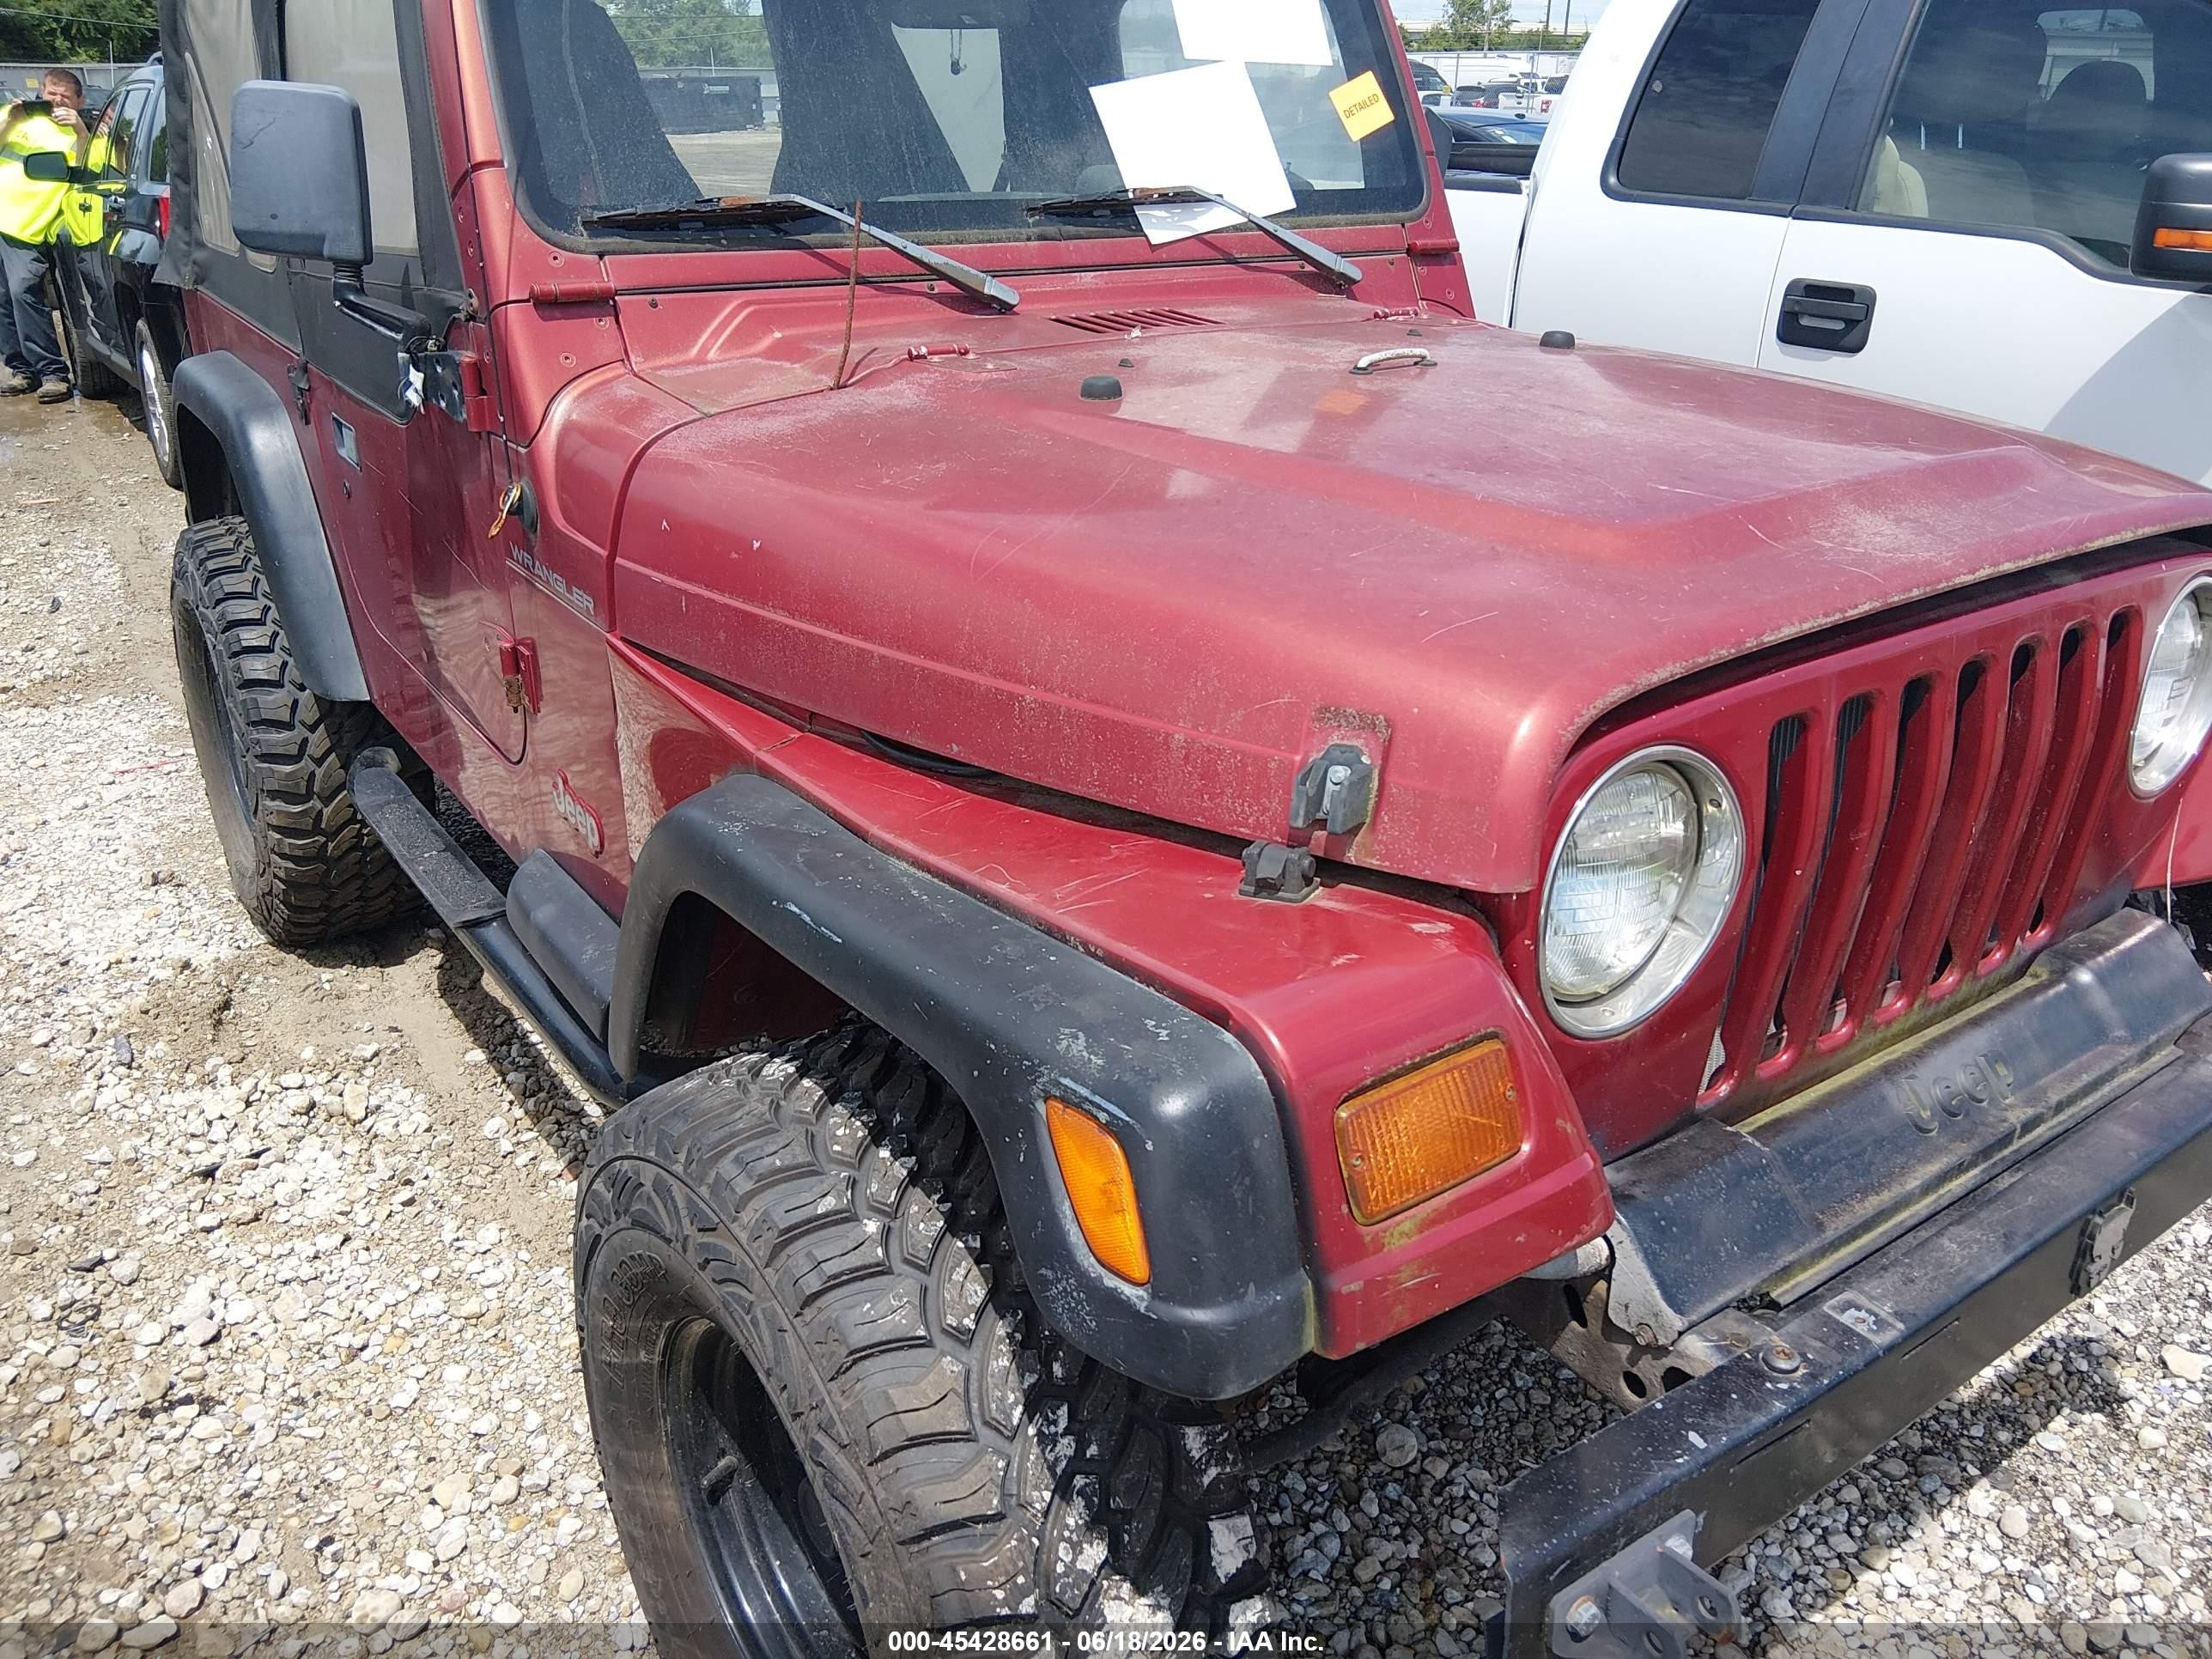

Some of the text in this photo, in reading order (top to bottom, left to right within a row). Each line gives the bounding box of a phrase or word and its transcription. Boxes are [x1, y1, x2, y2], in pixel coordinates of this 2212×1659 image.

[1343, 94, 1380, 118] DETAILED
[509, 541, 594, 616] WRANGLER
[552, 773, 603, 853] Jeep
[1899, 1052, 2014, 1135] Jeep
